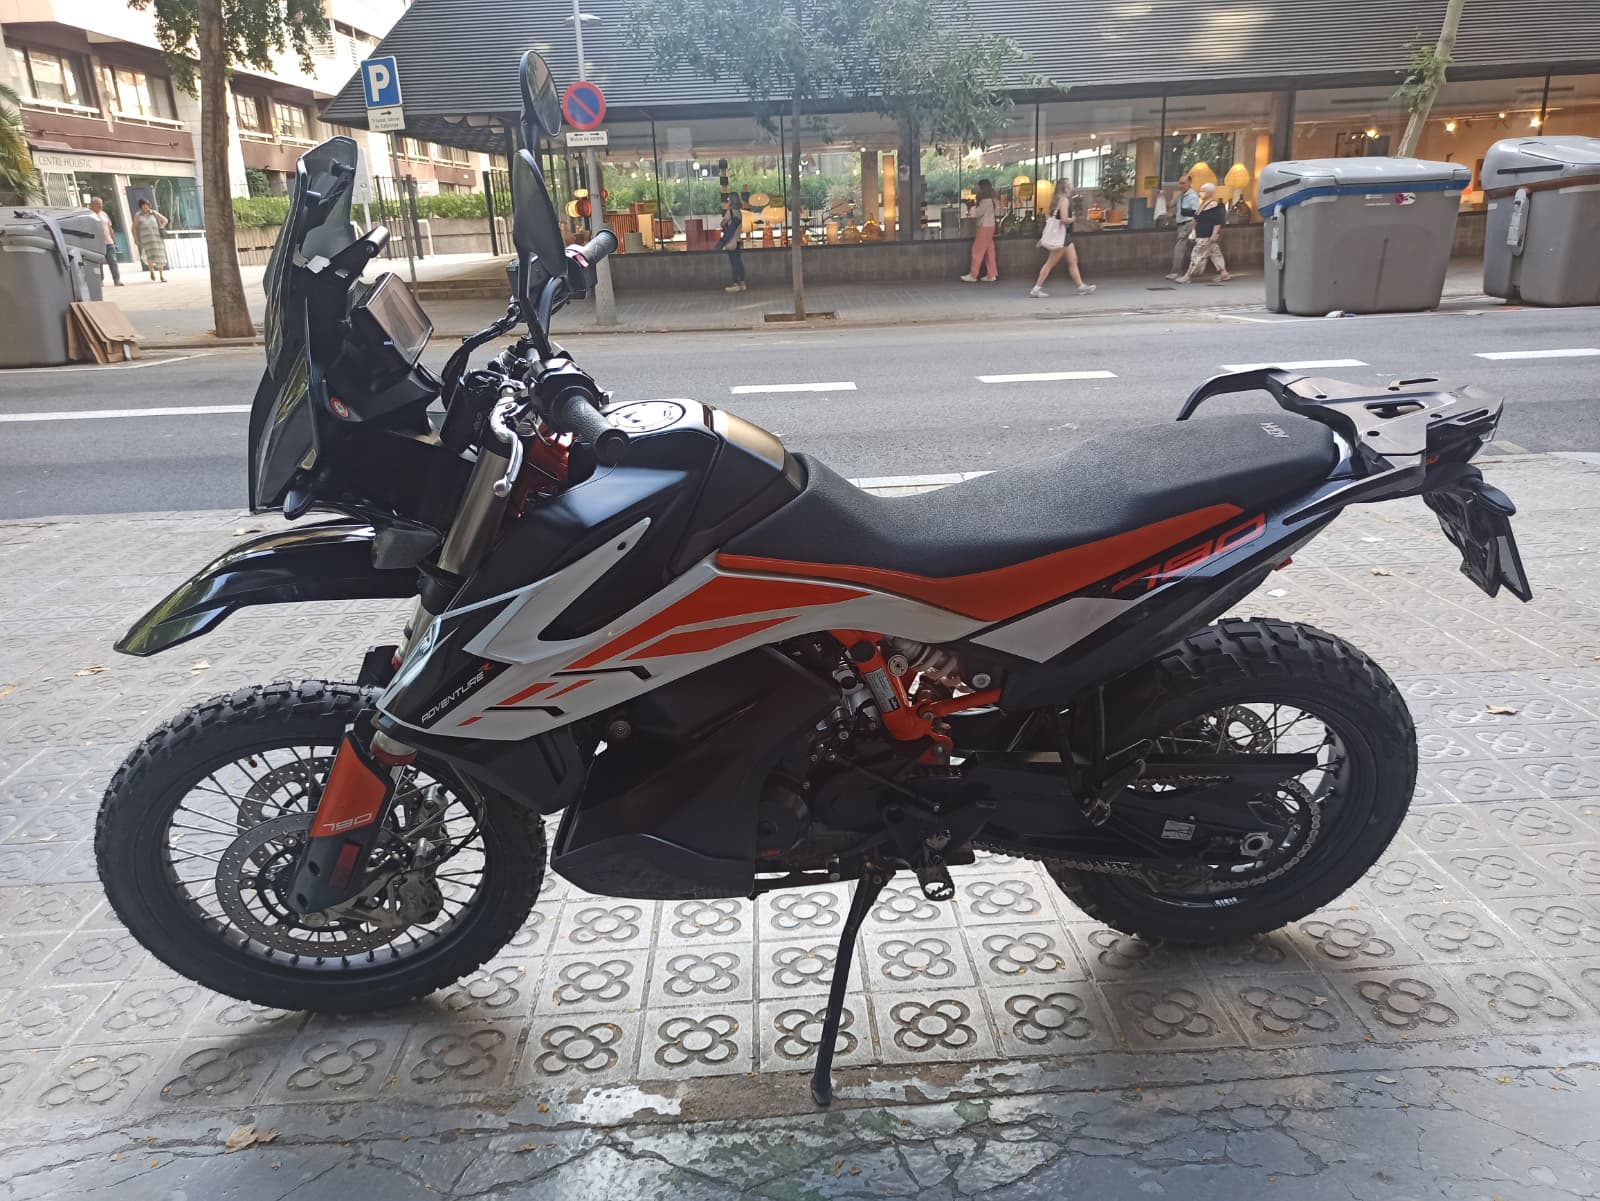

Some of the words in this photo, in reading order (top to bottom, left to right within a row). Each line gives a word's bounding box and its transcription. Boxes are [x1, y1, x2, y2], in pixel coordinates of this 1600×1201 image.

[368, 64, 390, 102] P
[38, 156, 63, 168] CENTRE
[1111, 513, 1265, 593] 790
[421, 671, 485, 724] ADVENTURE
[322, 811, 373, 831] 790
